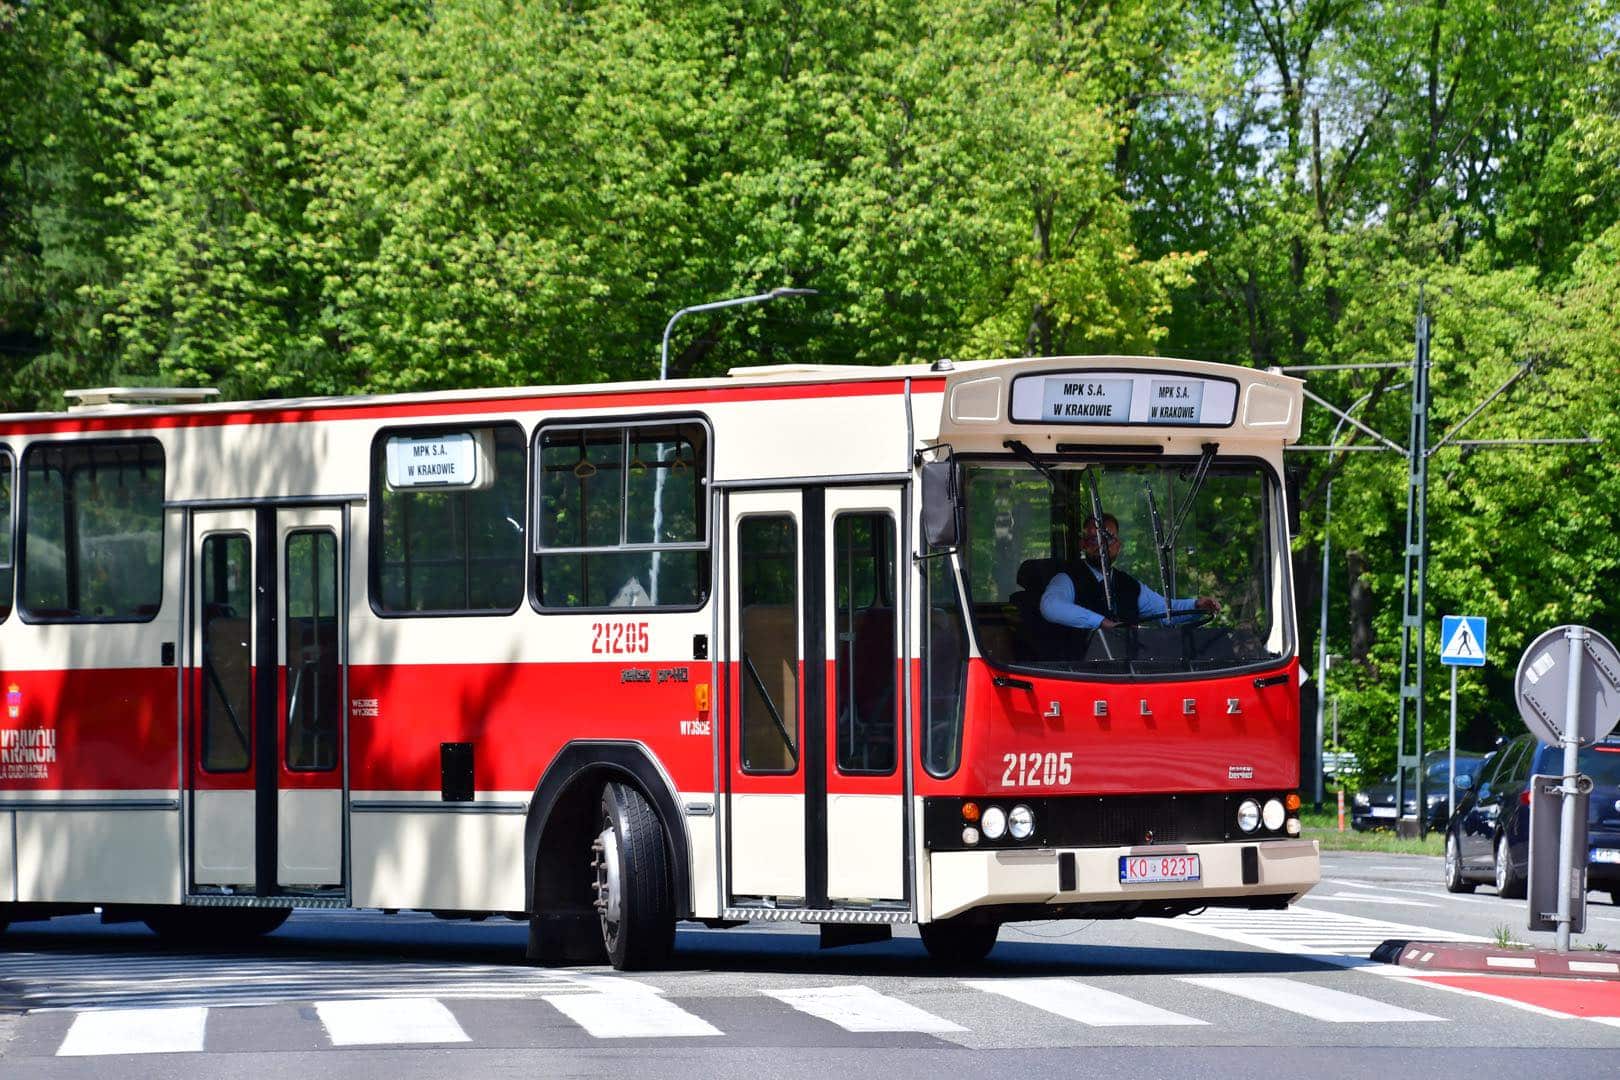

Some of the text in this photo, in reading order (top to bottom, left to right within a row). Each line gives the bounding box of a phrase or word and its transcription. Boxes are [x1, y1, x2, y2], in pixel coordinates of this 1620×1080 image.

[1063, 383, 1106, 397] MPK S.A.
[1158, 386, 1190, 399] MPK S.A.
[1053, 403, 1112, 417] W KRAKOWIE
[1151, 406, 1194, 419] W KRAKOWIE
[413, 444, 448, 457] MPK S.A.
[407, 463, 455, 476] W KRAKOWIE
[591, 622, 649, 654] 21205
[1001, 752, 1073, 787] 21205
[1129, 859, 1147, 878] KO
[1161, 857, 1195, 877] 823T
